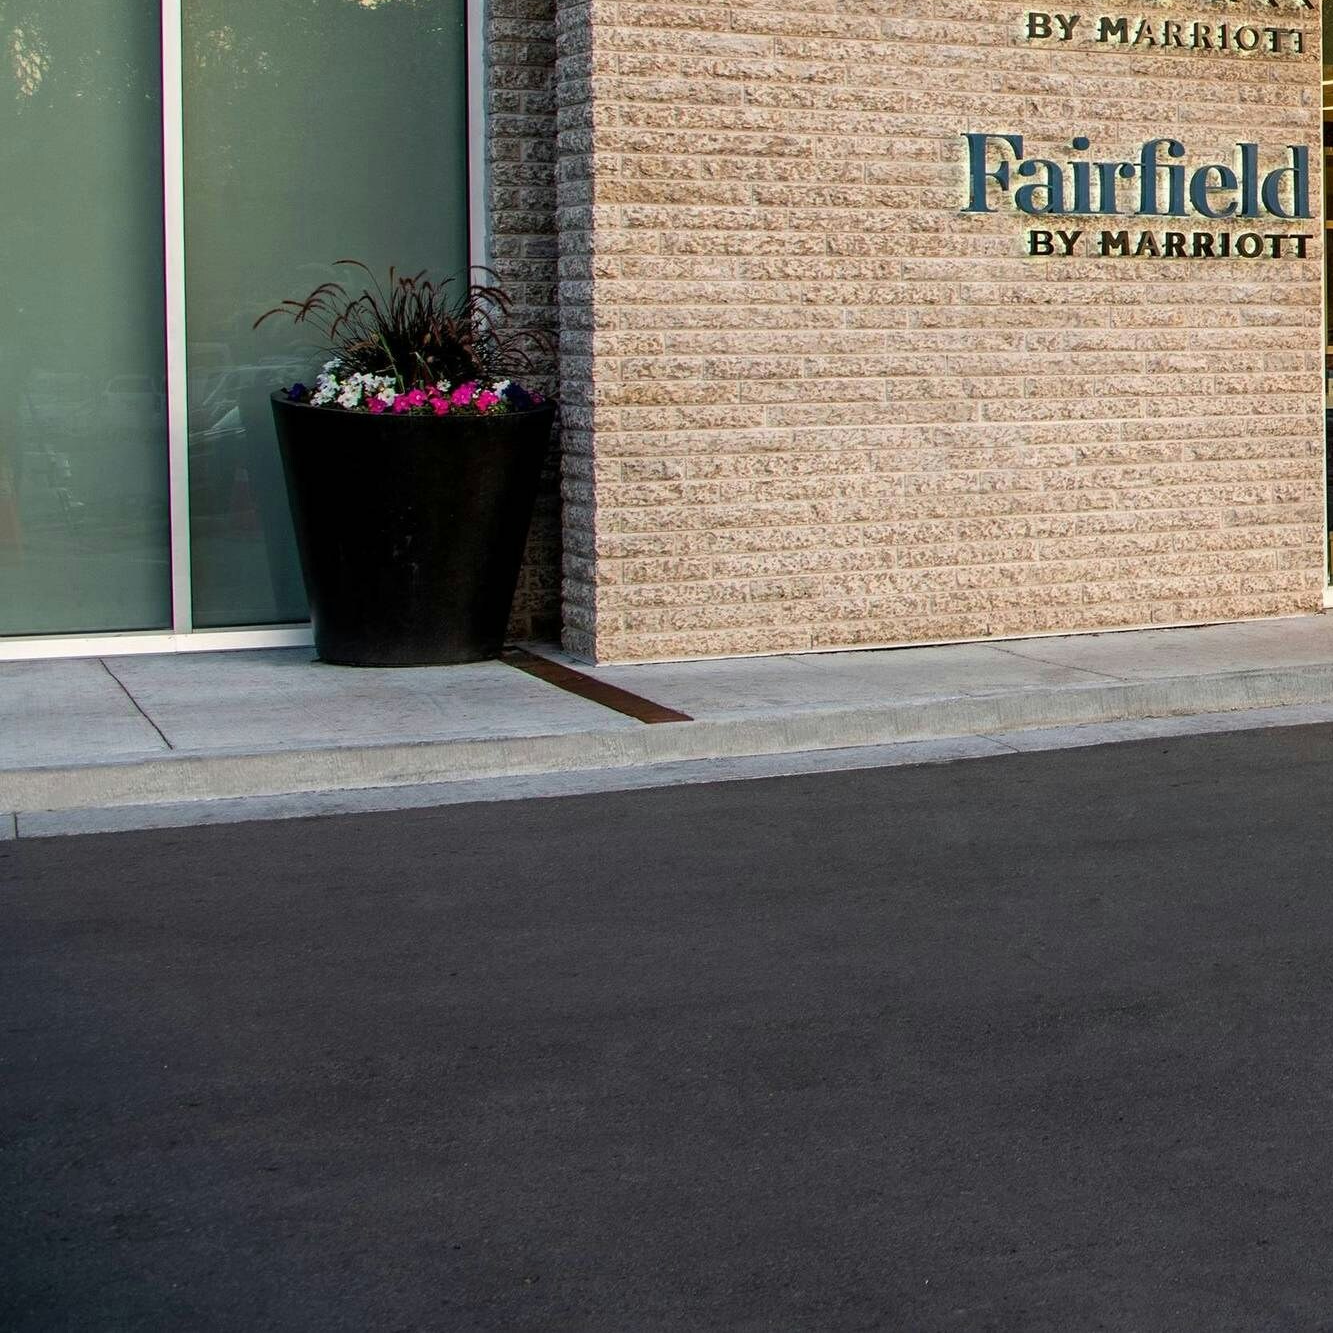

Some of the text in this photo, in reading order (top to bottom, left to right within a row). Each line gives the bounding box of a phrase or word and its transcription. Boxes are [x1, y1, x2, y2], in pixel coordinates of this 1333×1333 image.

[1027, 12, 1312, 53] BY MARRIOTT
[960, 132, 1314, 218] Fairfield
[1029, 230, 1313, 259] BY MARRIOTT
